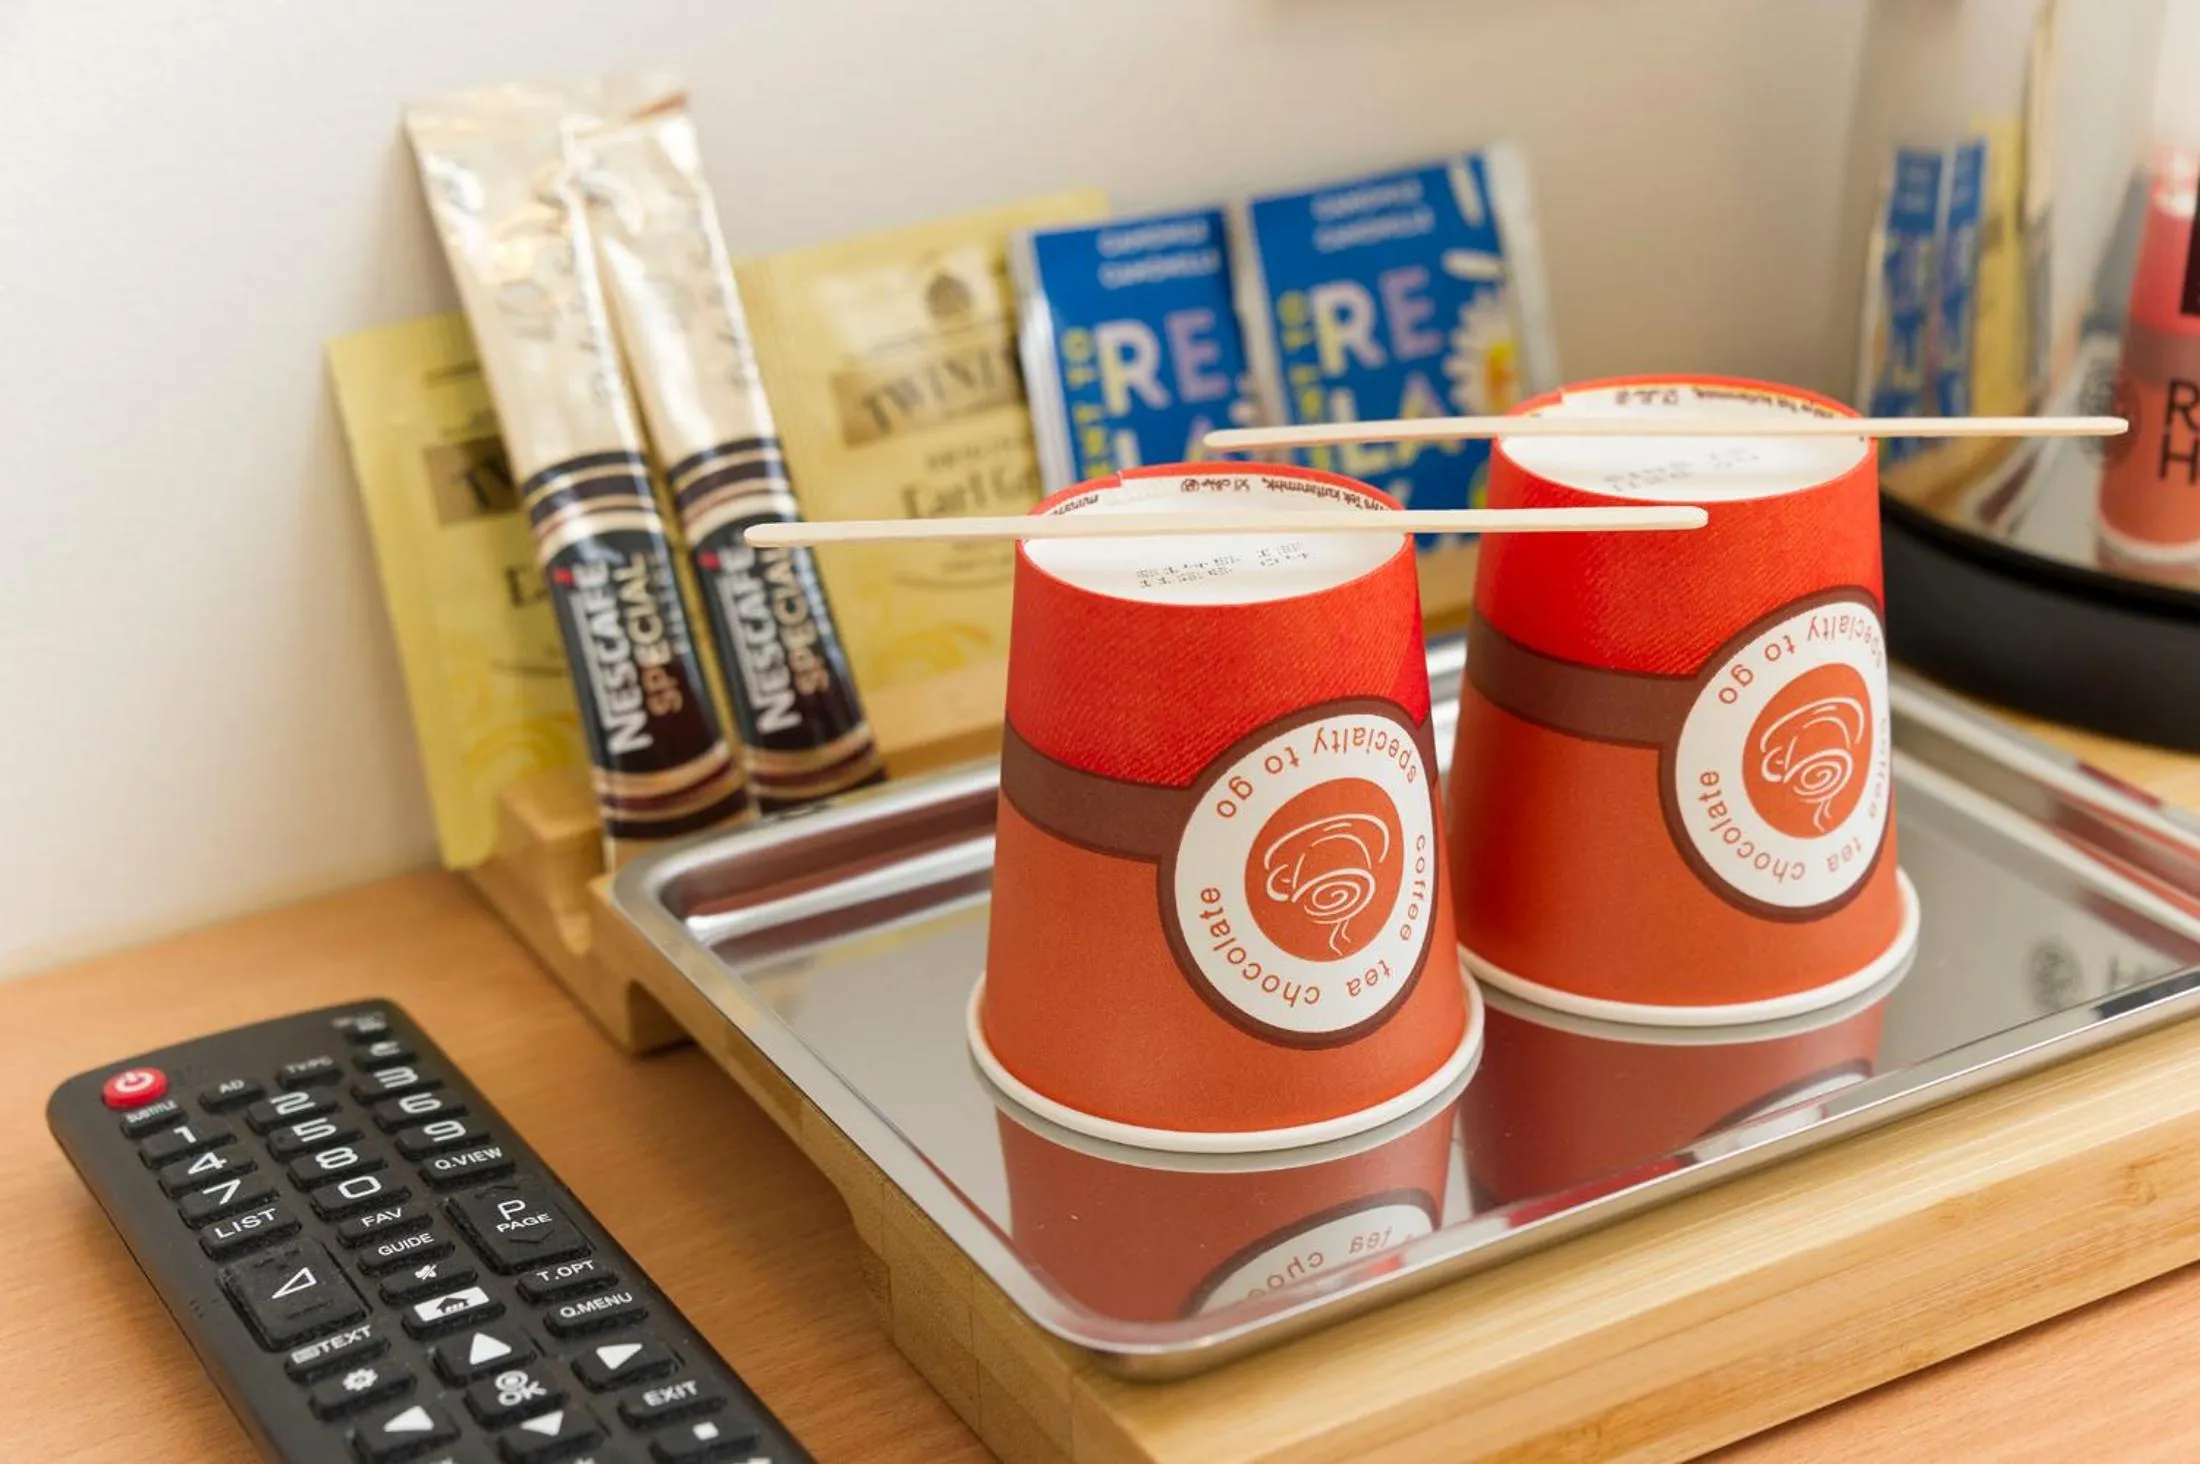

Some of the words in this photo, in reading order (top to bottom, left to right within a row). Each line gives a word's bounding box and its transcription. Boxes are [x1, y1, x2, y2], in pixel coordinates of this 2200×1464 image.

[1310, 266, 1442, 380] RE
[1096, 306, 1230, 416] RE
[616, 554, 684, 717] SPECIAL
[1764, 635, 1796, 662] to
[1719, 664, 1754, 704] go
[1264, 746, 1300, 775] to
[1313, 727, 1417, 783] specialty
[1217, 775, 1254, 818] go
[1697, 771, 1806, 884] chocolate
[1826, 837, 1862, 873] tea
[1399, 834, 1426, 942] coffee
[1200, 887, 1321, 1008] chocolate
[1346, 959, 1391, 997] tea
[219, 1079, 245, 1094] AD
[374, 1066, 419, 1089] 3
[125, 1100, 179, 1123] SUBTITLE
[270, 1092, 316, 1116] 2
[399, 1092, 442, 1114] 6
[173, 1126, 197, 1143] 1
[292, 1118, 337, 1142] 5
[424, 1120, 467, 1142] 9
[187, 1152, 228, 1175] 4
[316, 1147, 358, 1170] 8
[434, 1147, 503, 1170] Q.VIEW
[202, 1178, 242, 1205] 7
[338, 1175, 382, 1199] 0
[214, 1207, 276, 1239] LIST
[361, 1208, 402, 1228] FAV
[496, 1213, 552, 1233] PAGE
[497, 1199, 526, 1221] P
[378, 1232, 434, 1256] GUIDE
[537, 1259, 595, 1282] T.OPT
[559, 1292, 633, 1318] Q.MENU
[315, 1324, 372, 1353] TEXT
[497, 1380, 549, 1406] OK
[642, 1379, 699, 1407] EXIT
